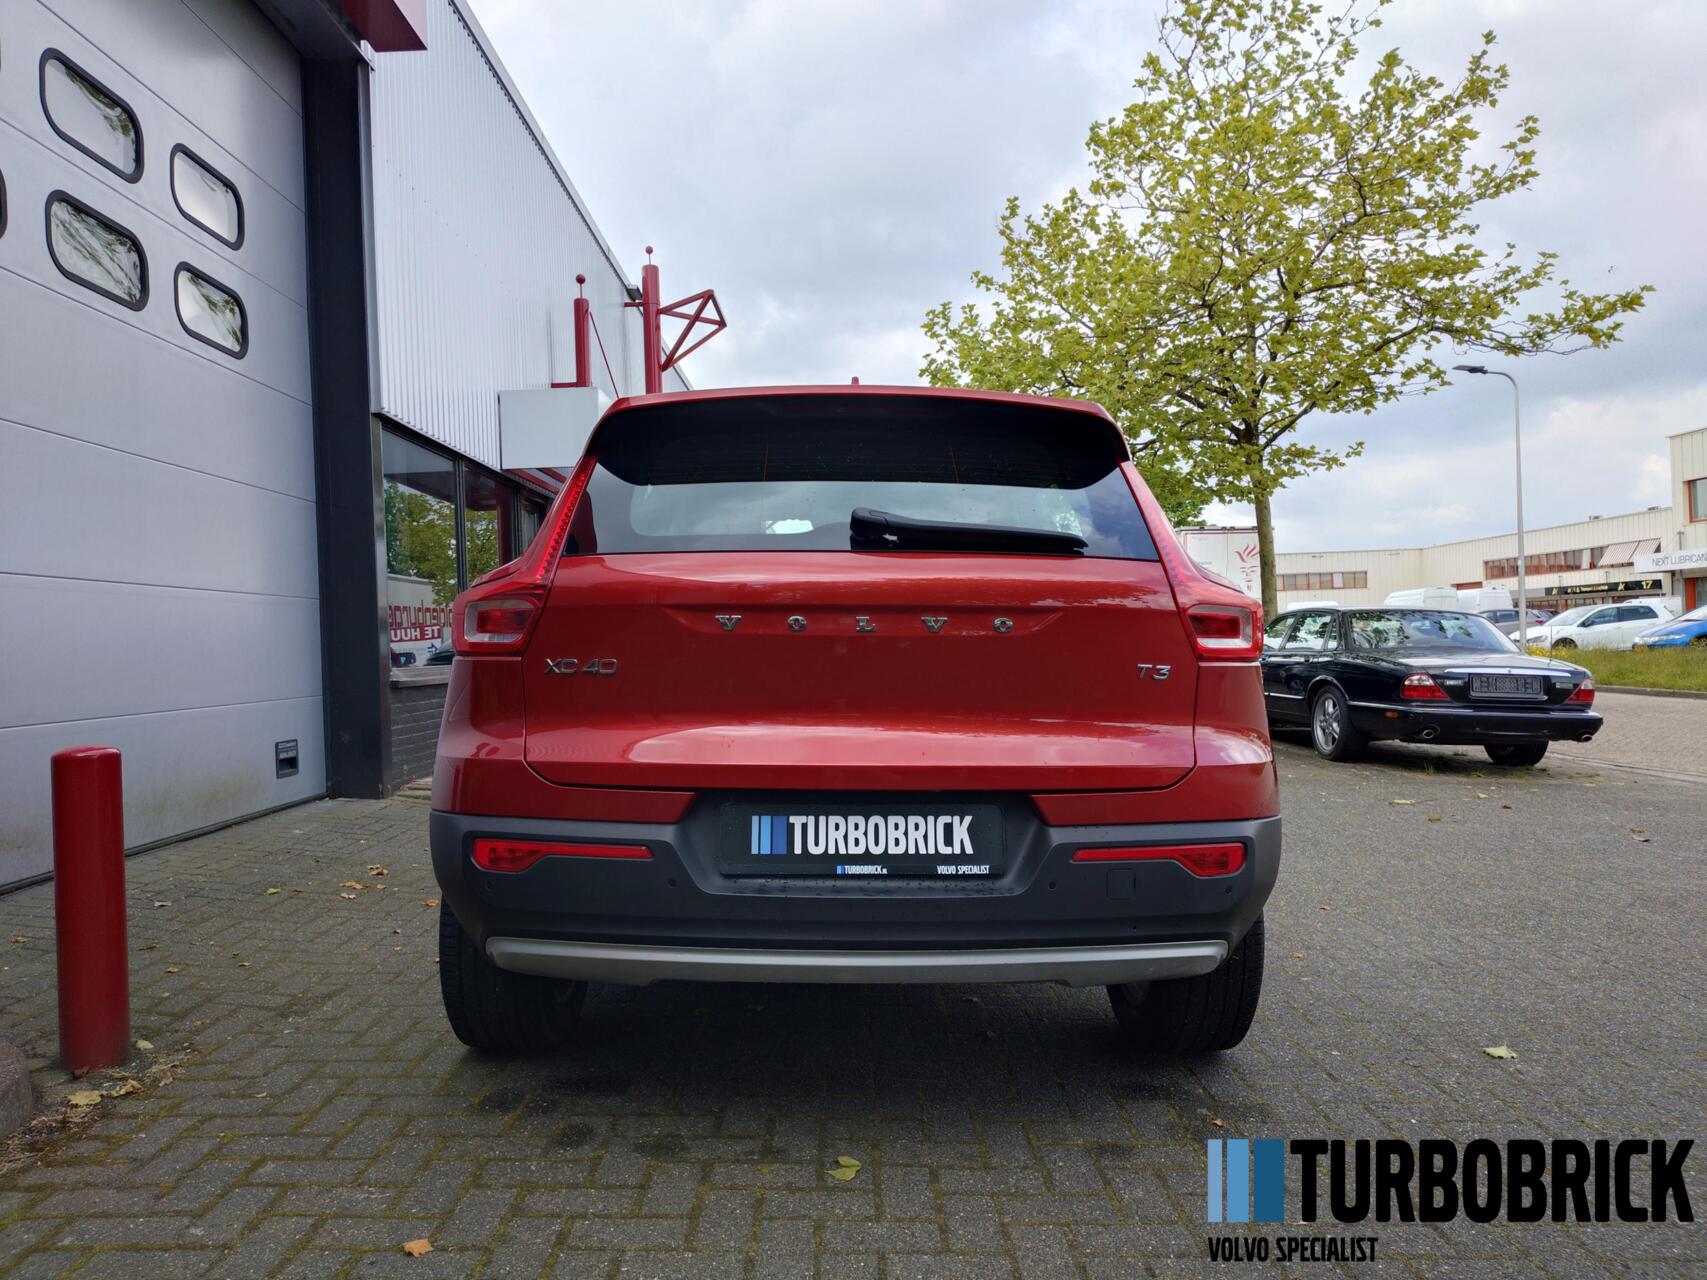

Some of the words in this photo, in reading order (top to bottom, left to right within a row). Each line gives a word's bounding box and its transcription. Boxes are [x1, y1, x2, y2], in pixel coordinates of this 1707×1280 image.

[1641, 580, 1653, 589] 17
[715, 614, 1015, 633] VOLVO
[1137, 663, 1171, 680] T3
[789, 815, 974, 855] TURBOBRICK
[937, 865, 957, 874] VOLVO
[957, 865, 990, 875] SPECIALIST
